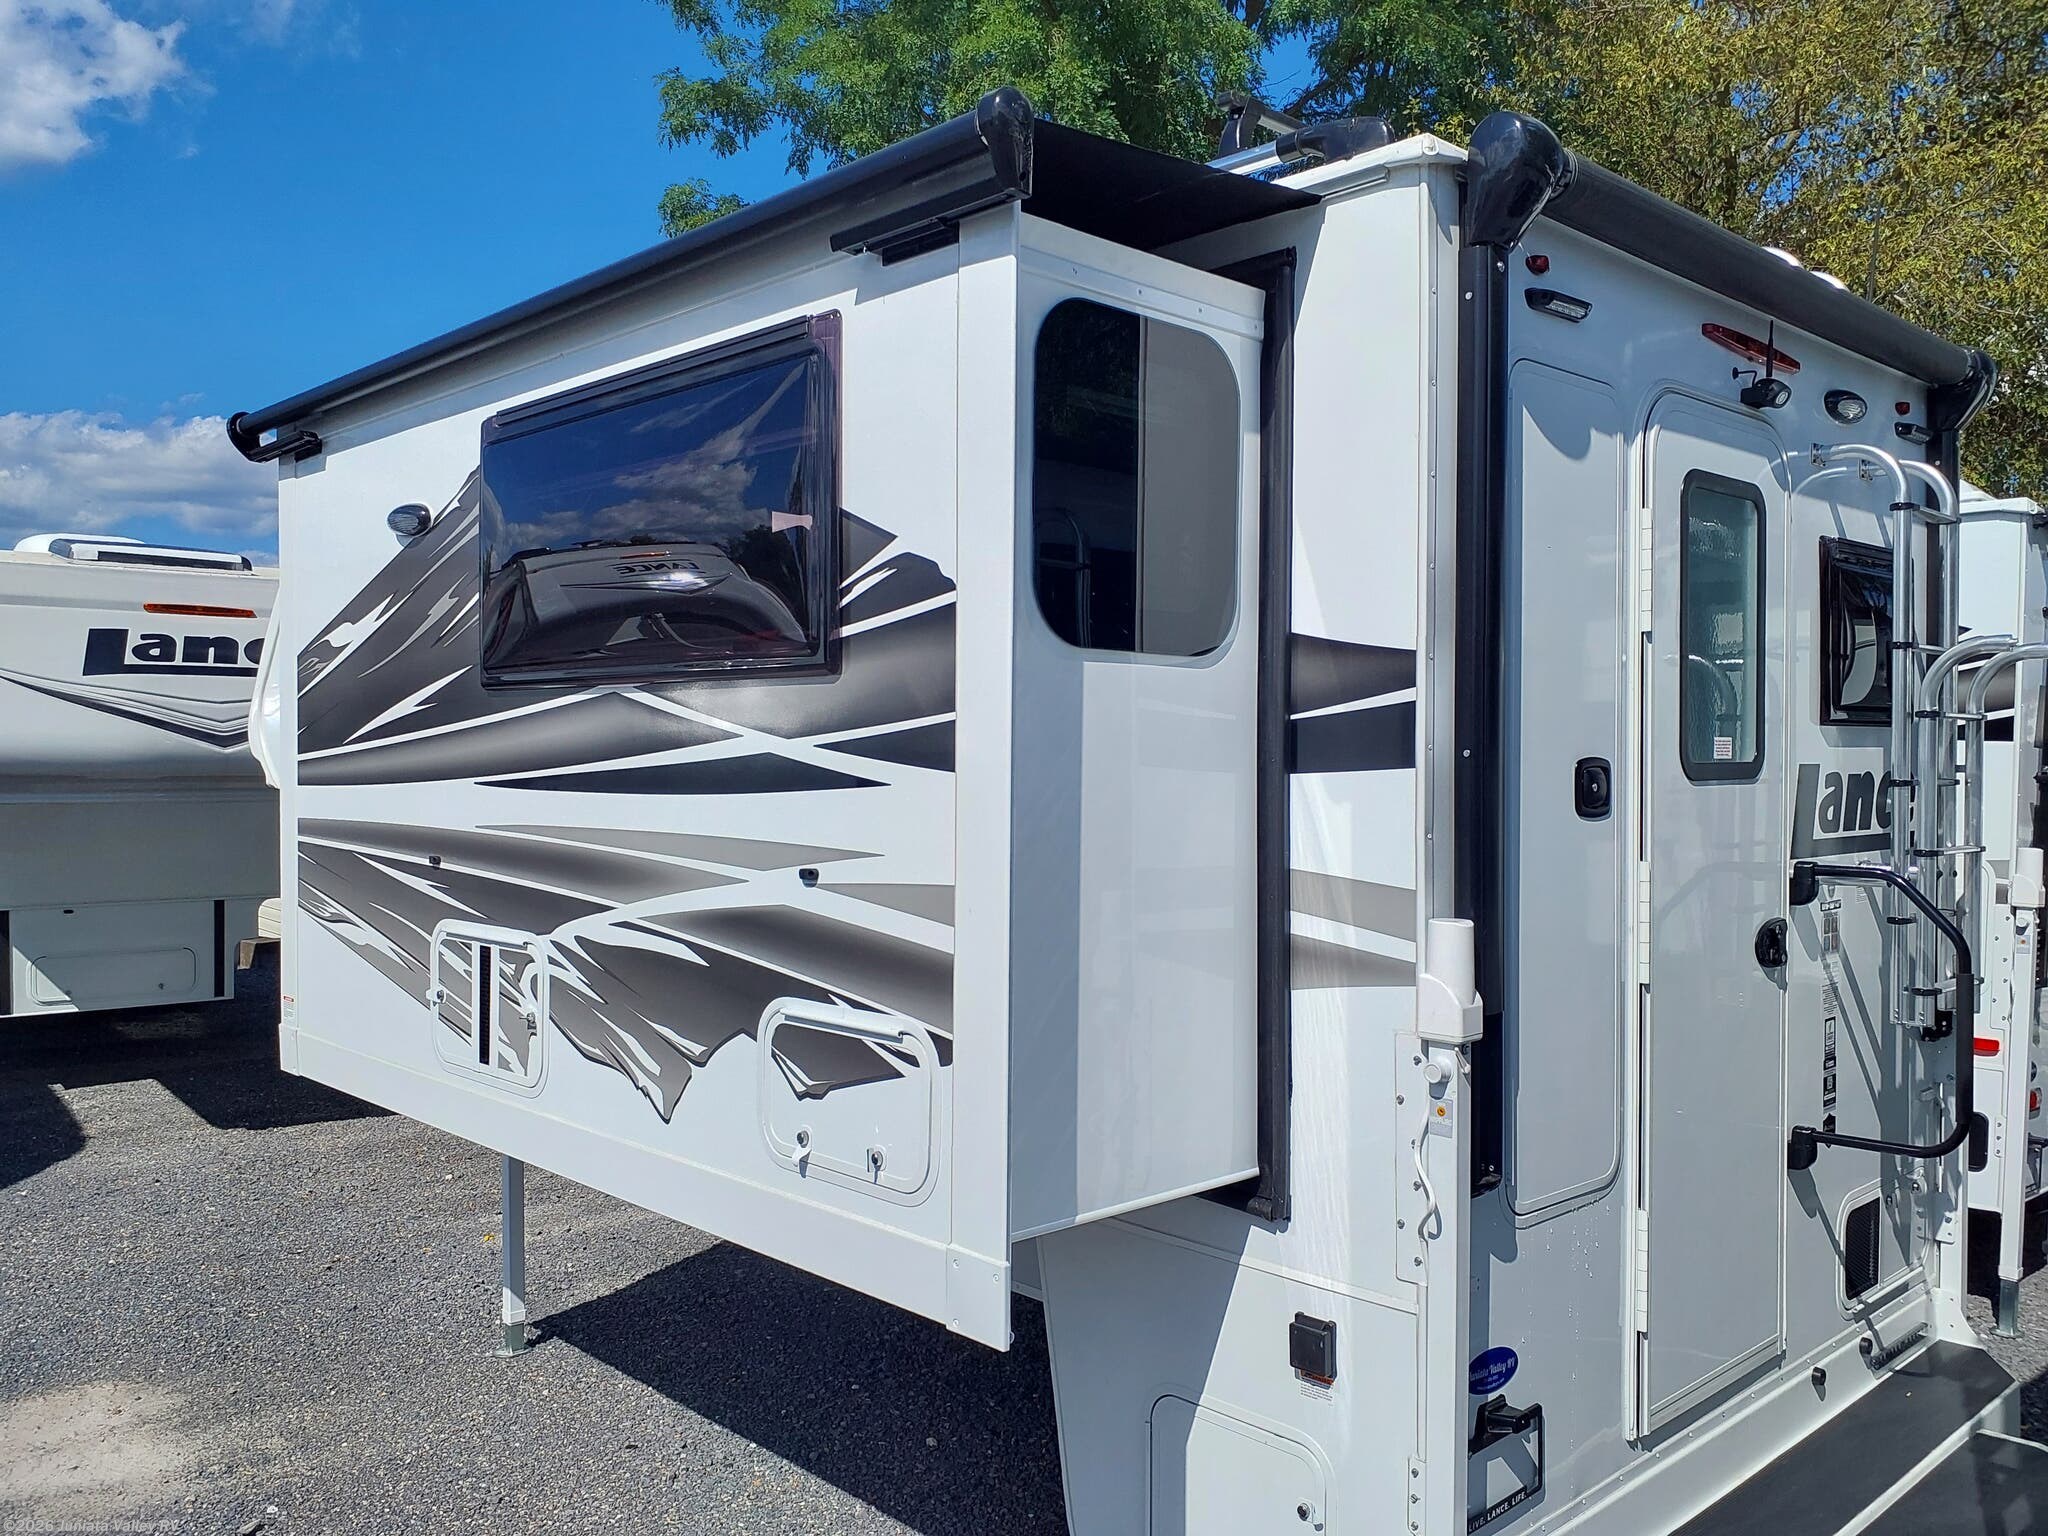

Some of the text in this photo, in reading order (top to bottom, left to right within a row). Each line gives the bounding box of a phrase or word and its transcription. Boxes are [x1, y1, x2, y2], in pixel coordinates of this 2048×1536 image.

[1790, 763, 1916, 860] Lanc
[1487, 1501, 1510, 1521] LANCE.
[1511, 1491, 1527, 1506] LIFE.
